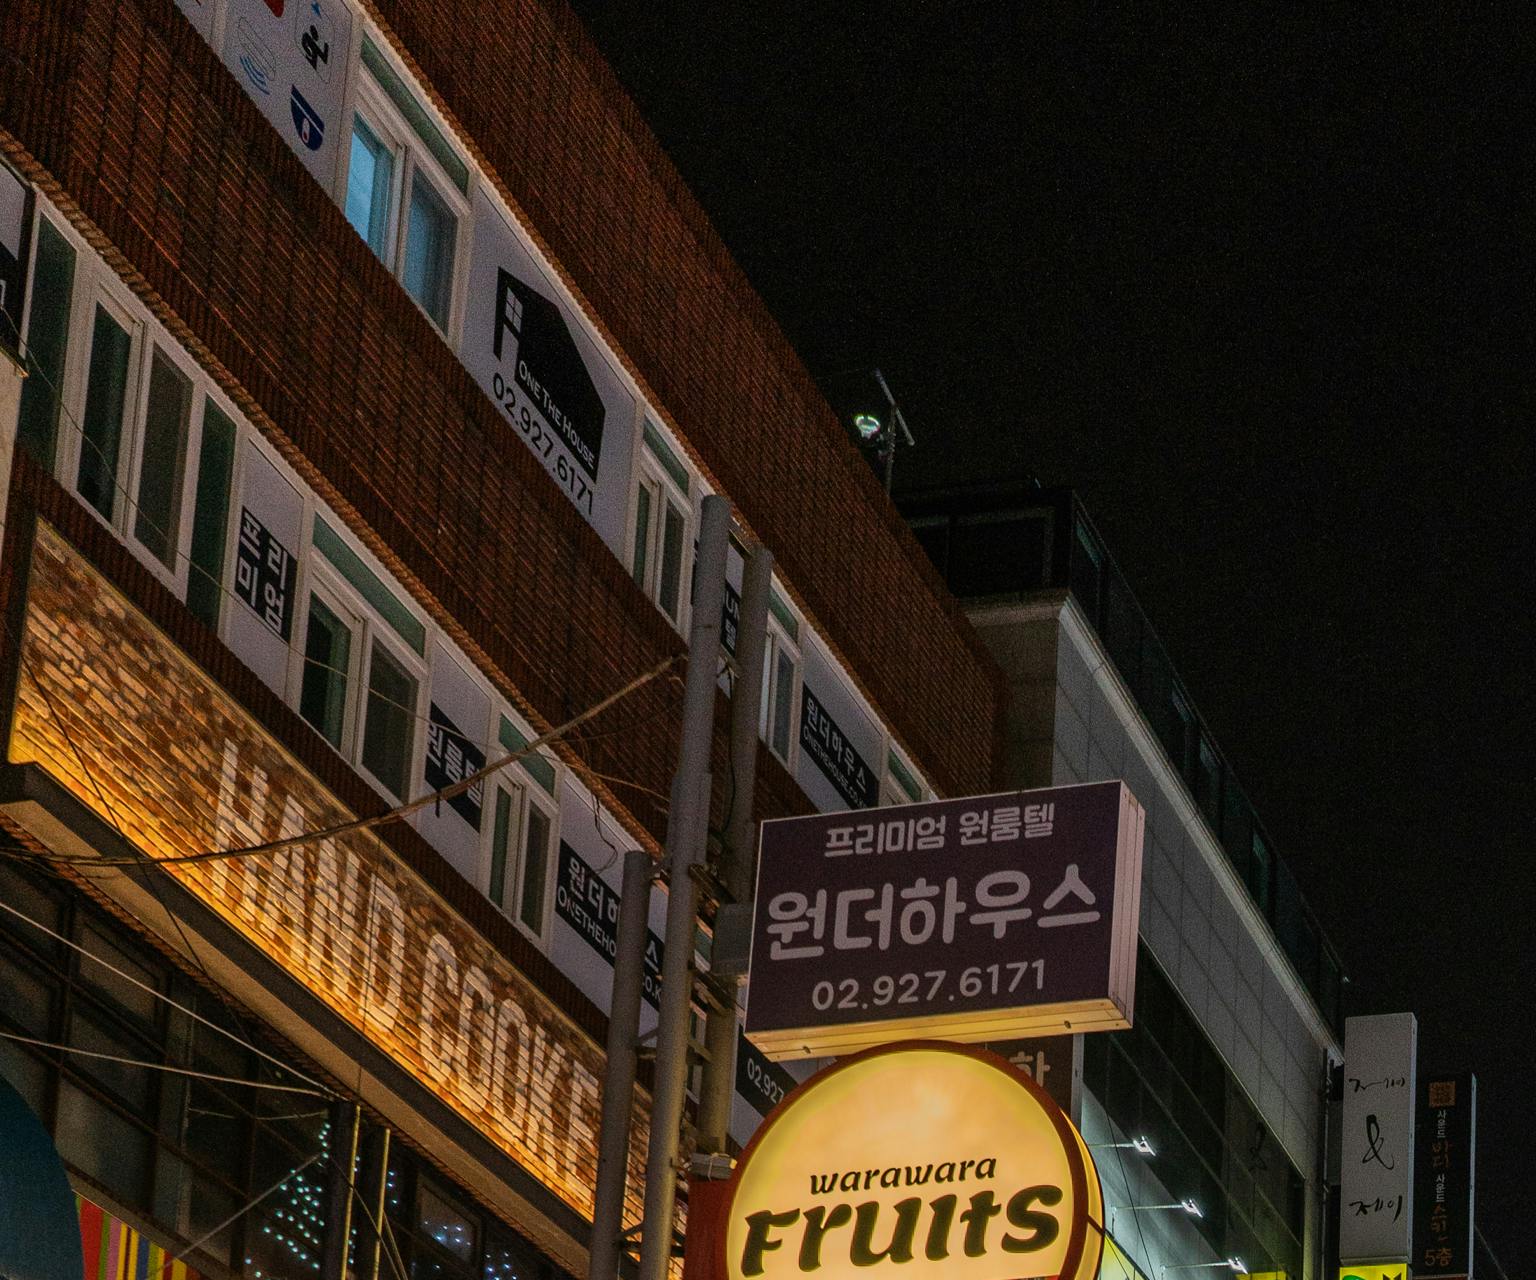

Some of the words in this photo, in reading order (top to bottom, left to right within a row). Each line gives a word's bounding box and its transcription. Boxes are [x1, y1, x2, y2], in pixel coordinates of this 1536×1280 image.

[491, 372, 597, 515] 02.927.6171
[519, 364, 540, 400] ONE
[541, 391, 563, 428] THE
[562, 416, 597, 469] HOUSE
[824, 814, 947, 859] 프리미엄
[958, 803, 1055, 846] 원룸텔
[213, 737, 408, 1036] HAND
[767, 862, 1101, 962] 원더하우스
[811, 958, 1047, 1012] 02.927.6171
[809, 1157, 998, 1195] warawara
